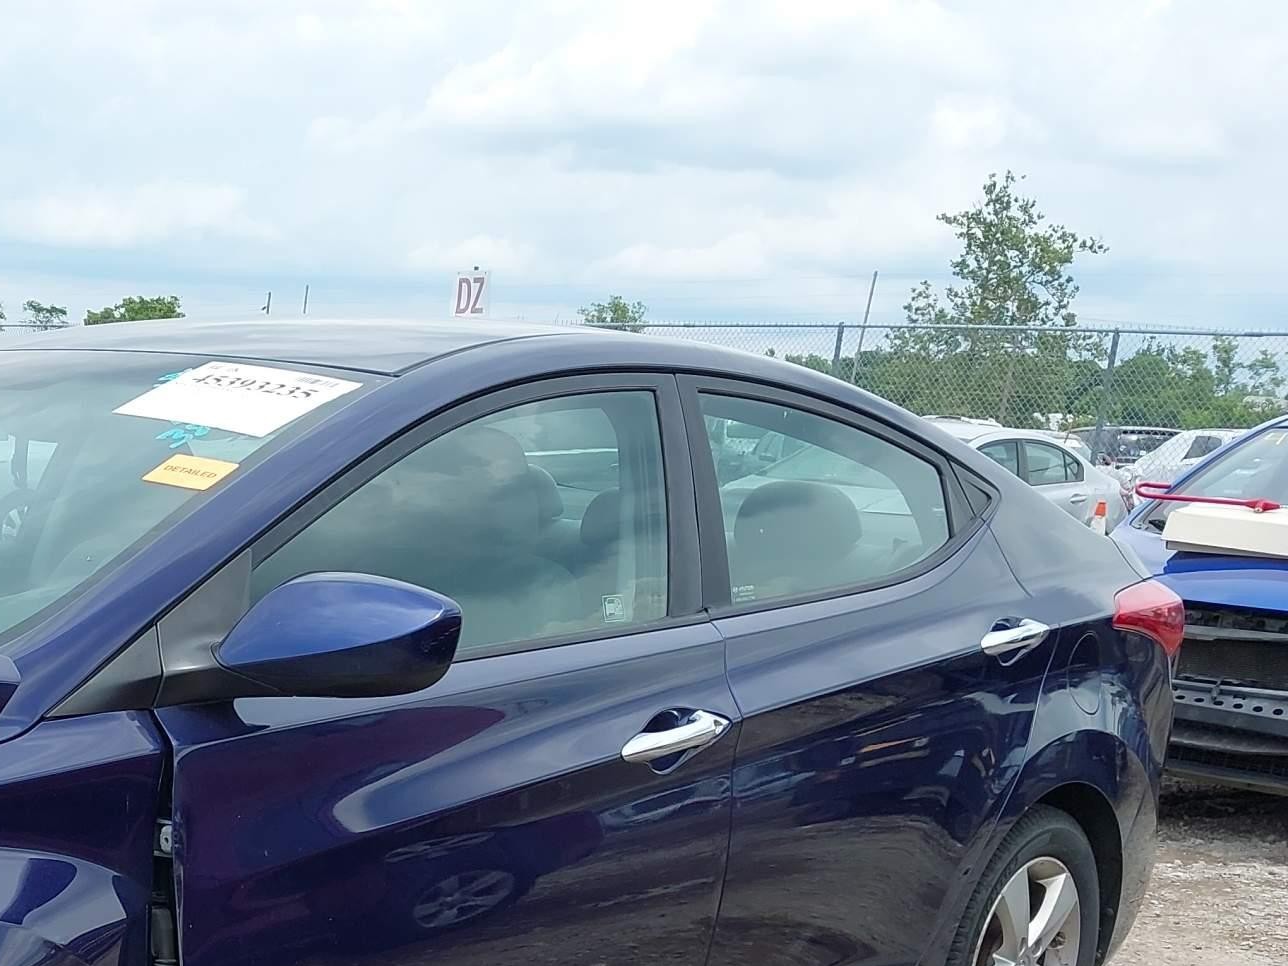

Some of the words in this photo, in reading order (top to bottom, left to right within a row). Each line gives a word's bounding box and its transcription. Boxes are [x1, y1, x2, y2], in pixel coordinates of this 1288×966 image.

[455, 276, 485, 314] DZ
[193, 373, 320, 400] 45393235
[163, 464, 218, 479] DETAILED
